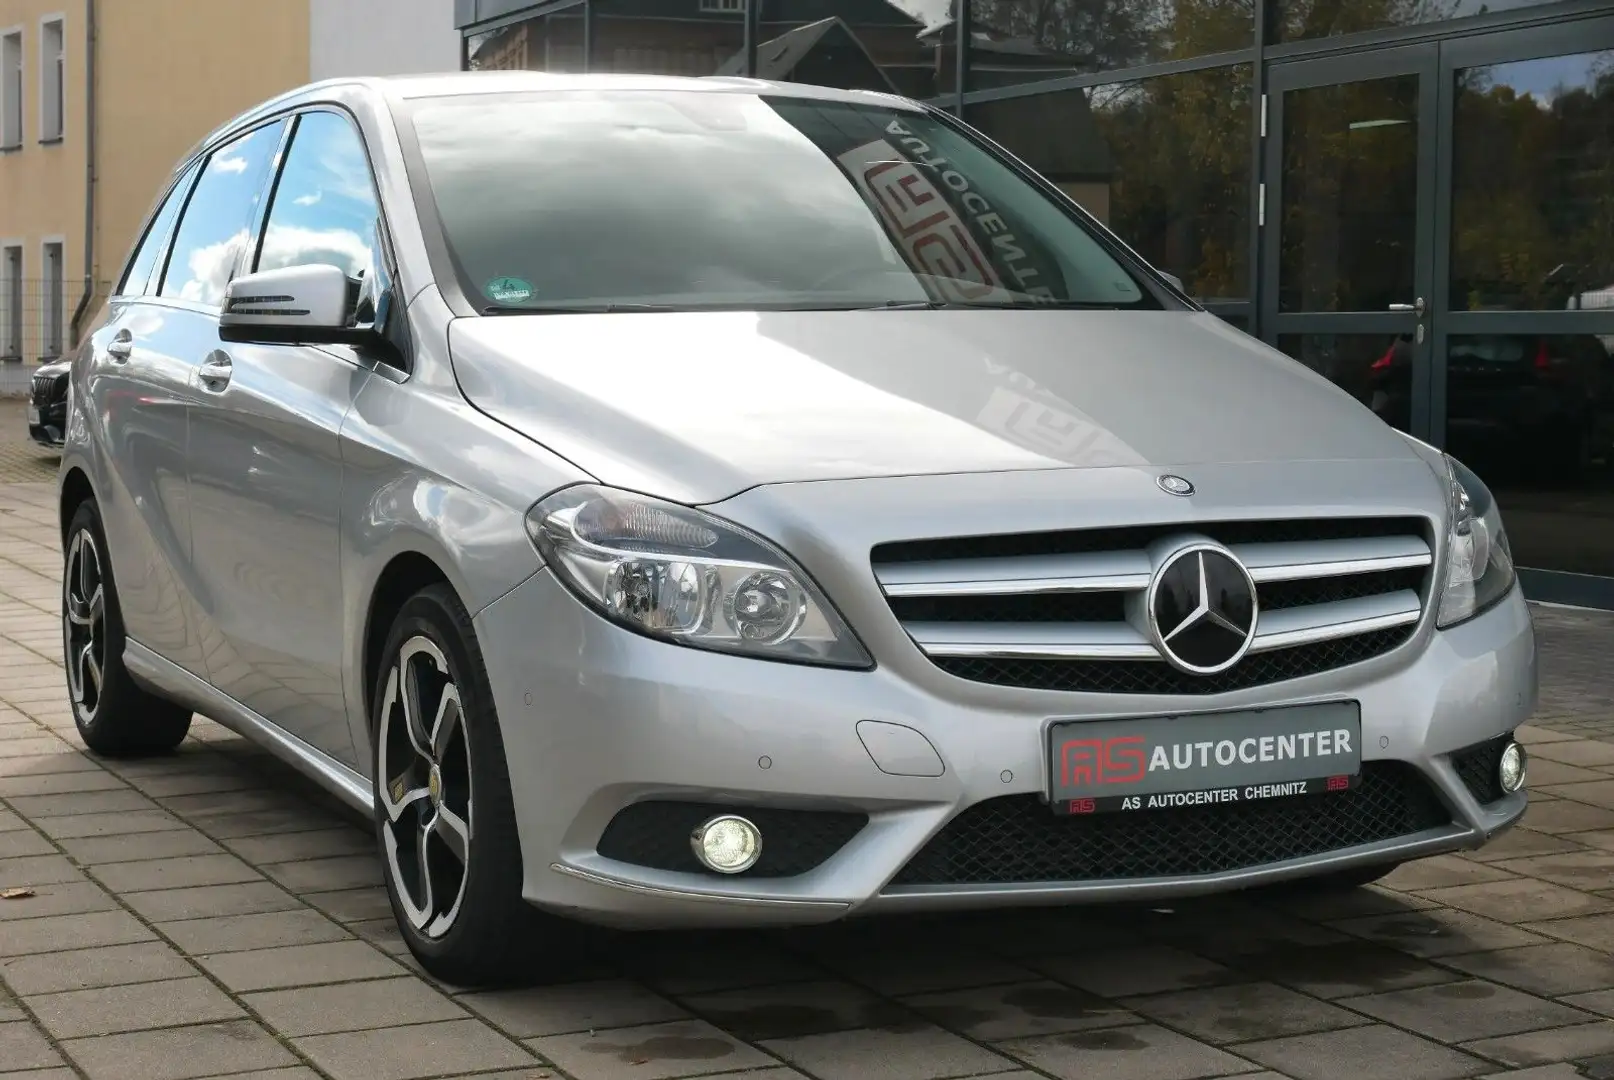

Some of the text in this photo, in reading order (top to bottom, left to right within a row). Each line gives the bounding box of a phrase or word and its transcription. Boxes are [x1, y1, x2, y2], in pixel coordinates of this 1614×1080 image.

[1061, 729, 1353, 787] AS AUTOCENTER
[1121, 782, 1307, 811] AS AUTOCENTER CHEMNITZ
